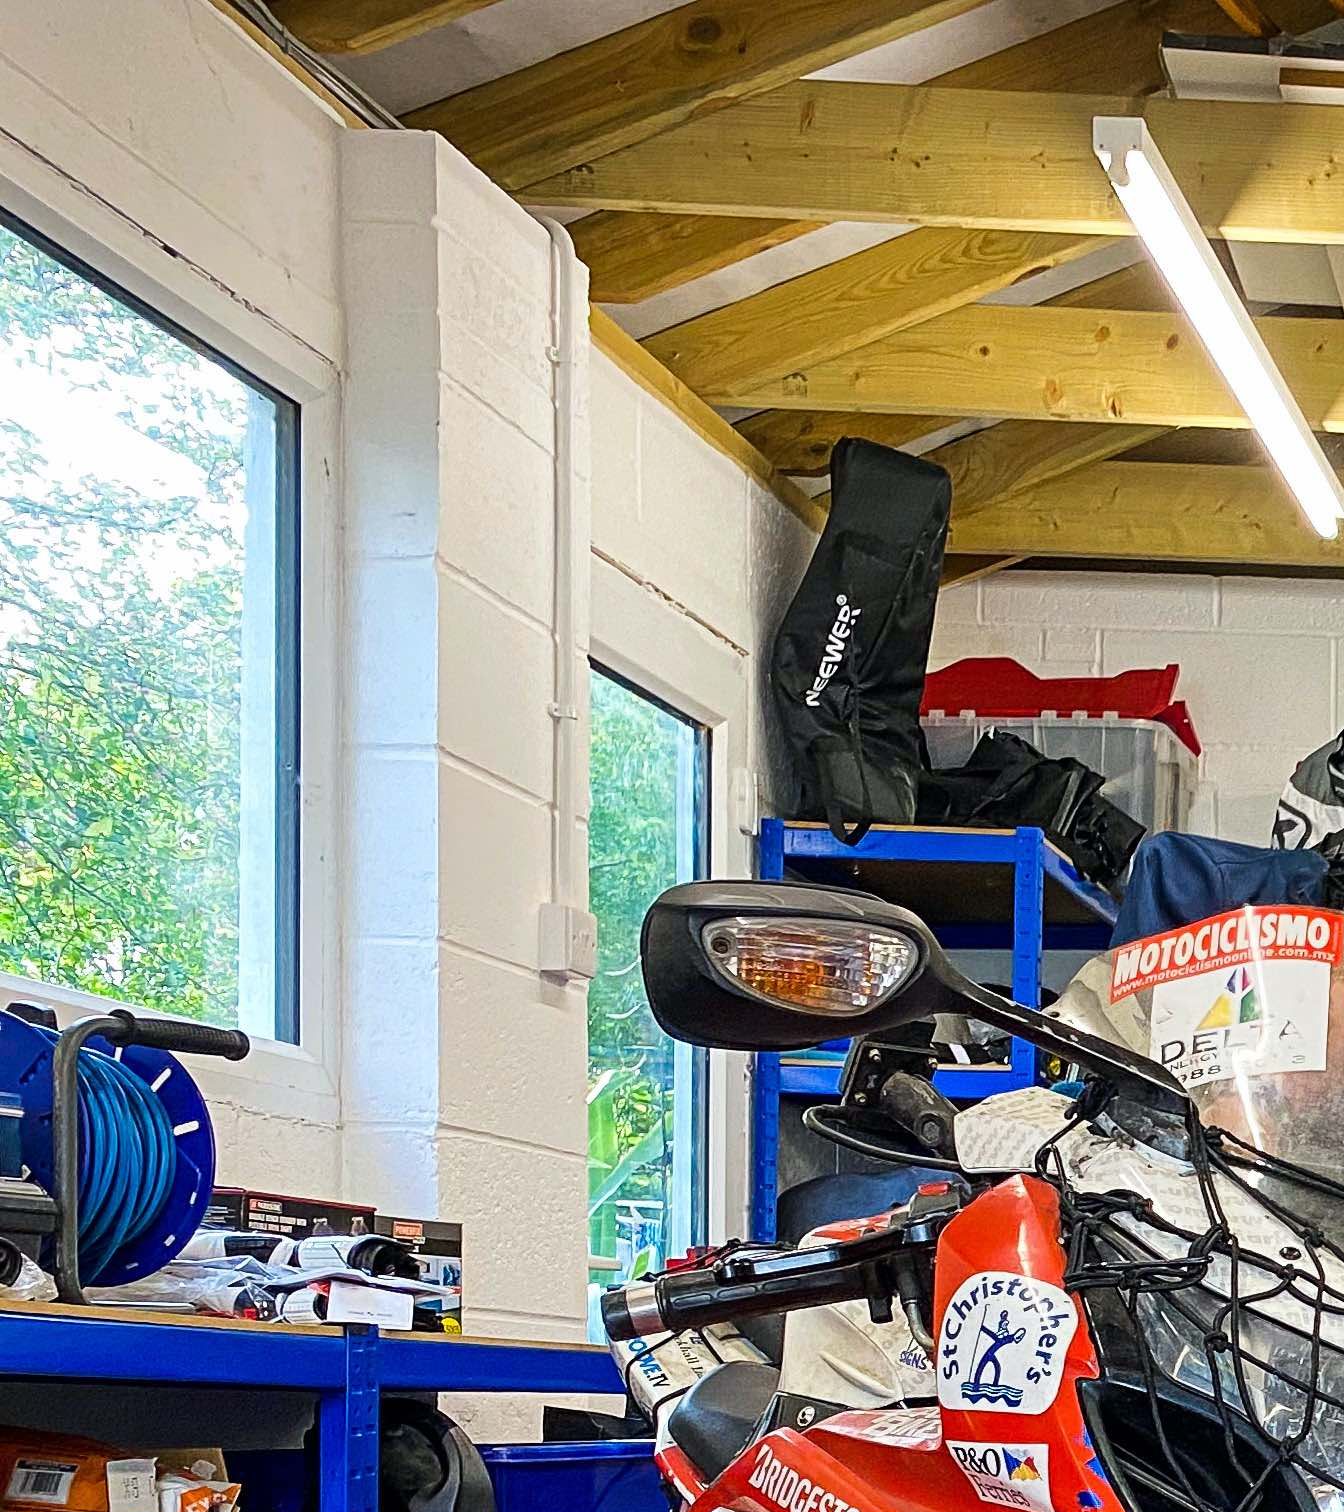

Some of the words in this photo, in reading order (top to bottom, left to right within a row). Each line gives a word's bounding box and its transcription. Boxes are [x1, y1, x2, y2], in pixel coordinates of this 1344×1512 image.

[804, 604, 861, 707] NEEWER
[1113, 947, 1336, 998] www.motociclismoonlne.com.mx
[952, 1445, 1001, 1478] P&O
[968, 1474, 1031, 1507] Ferries
